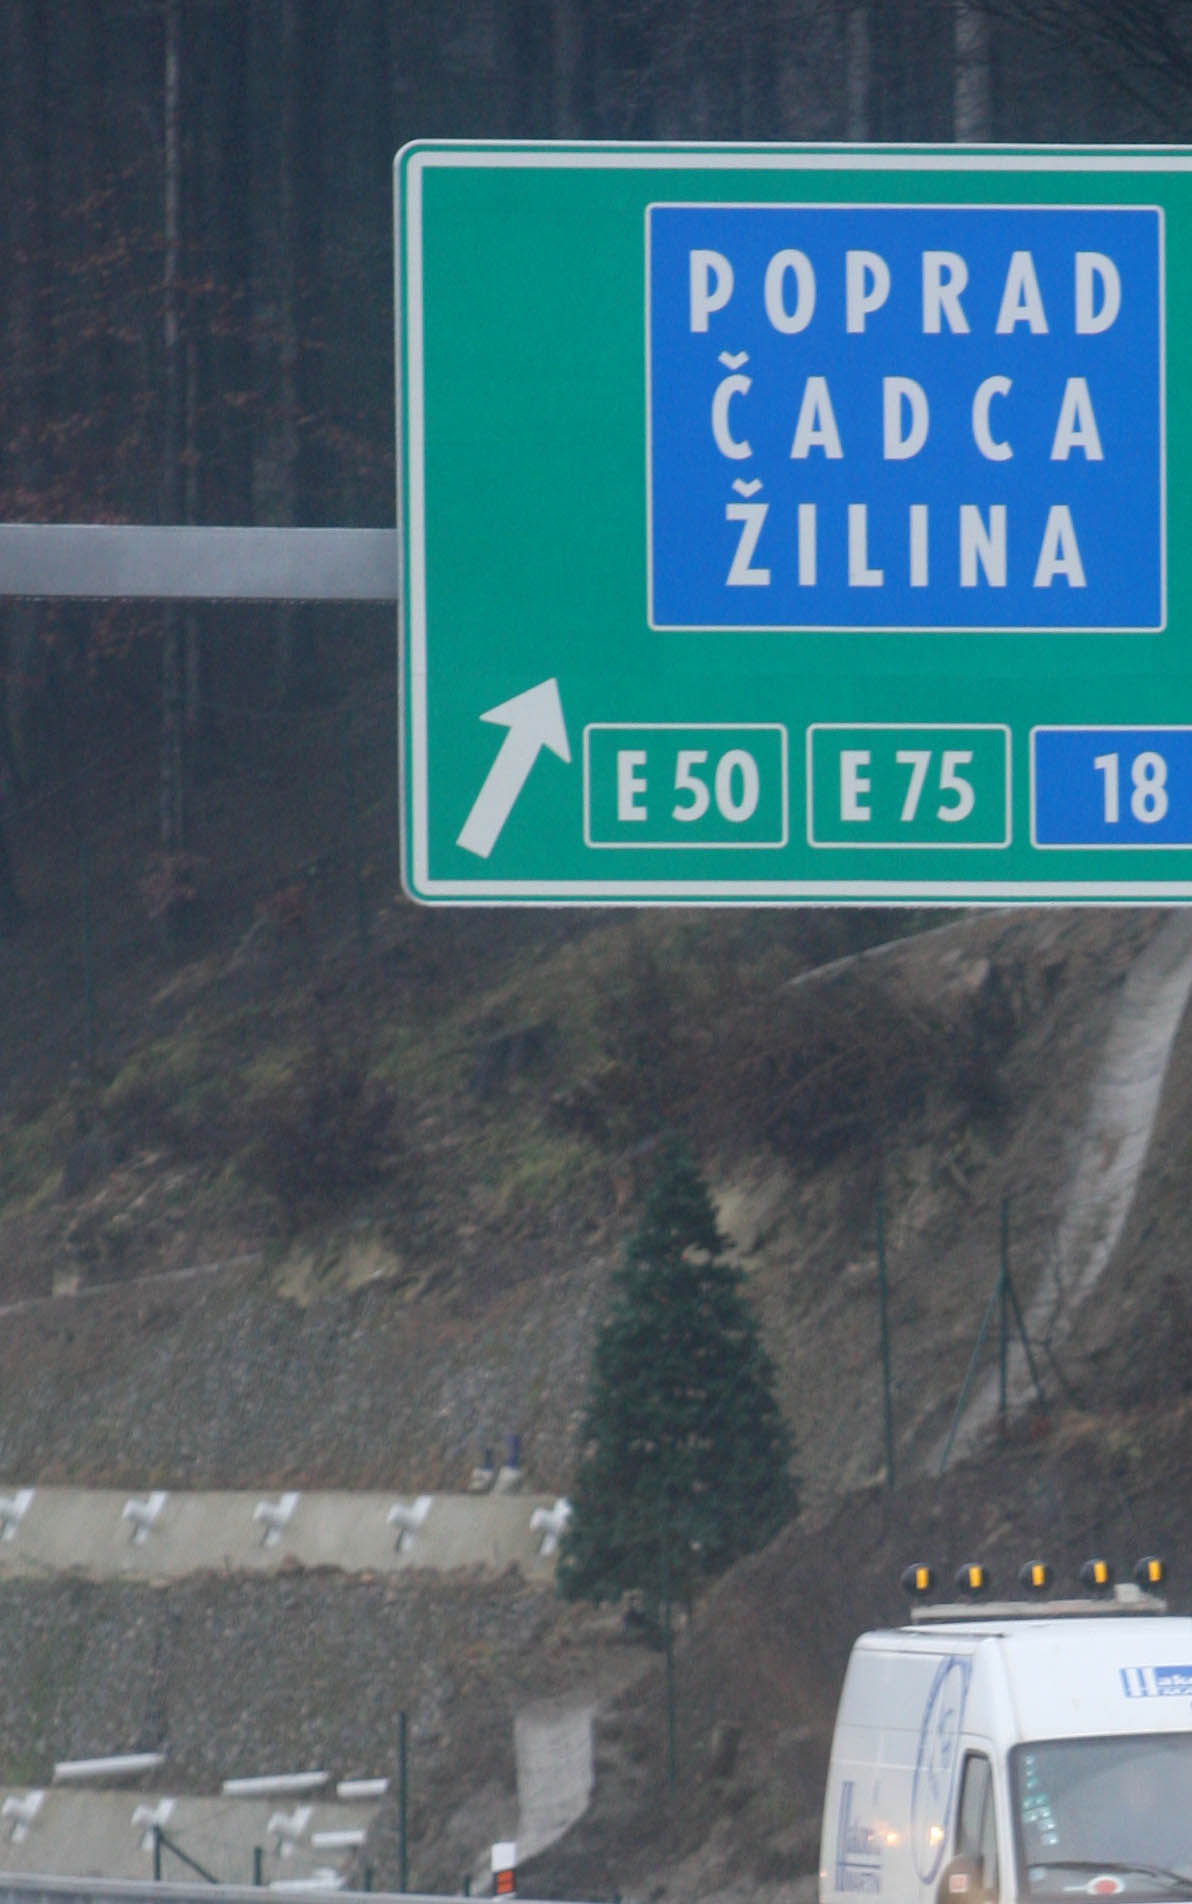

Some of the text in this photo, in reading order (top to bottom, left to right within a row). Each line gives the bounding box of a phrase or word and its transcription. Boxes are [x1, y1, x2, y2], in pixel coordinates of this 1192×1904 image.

[690, 249, 1120, 334] POPRAD
[712, 352, 1104, 461] ČADCA
[726, 479, 1087, 587] ŽILINA
[618, 750, 758, 822] E 50
[841, 751, 975, 821] E 75
[1095, 752, 1169, 823] 18
